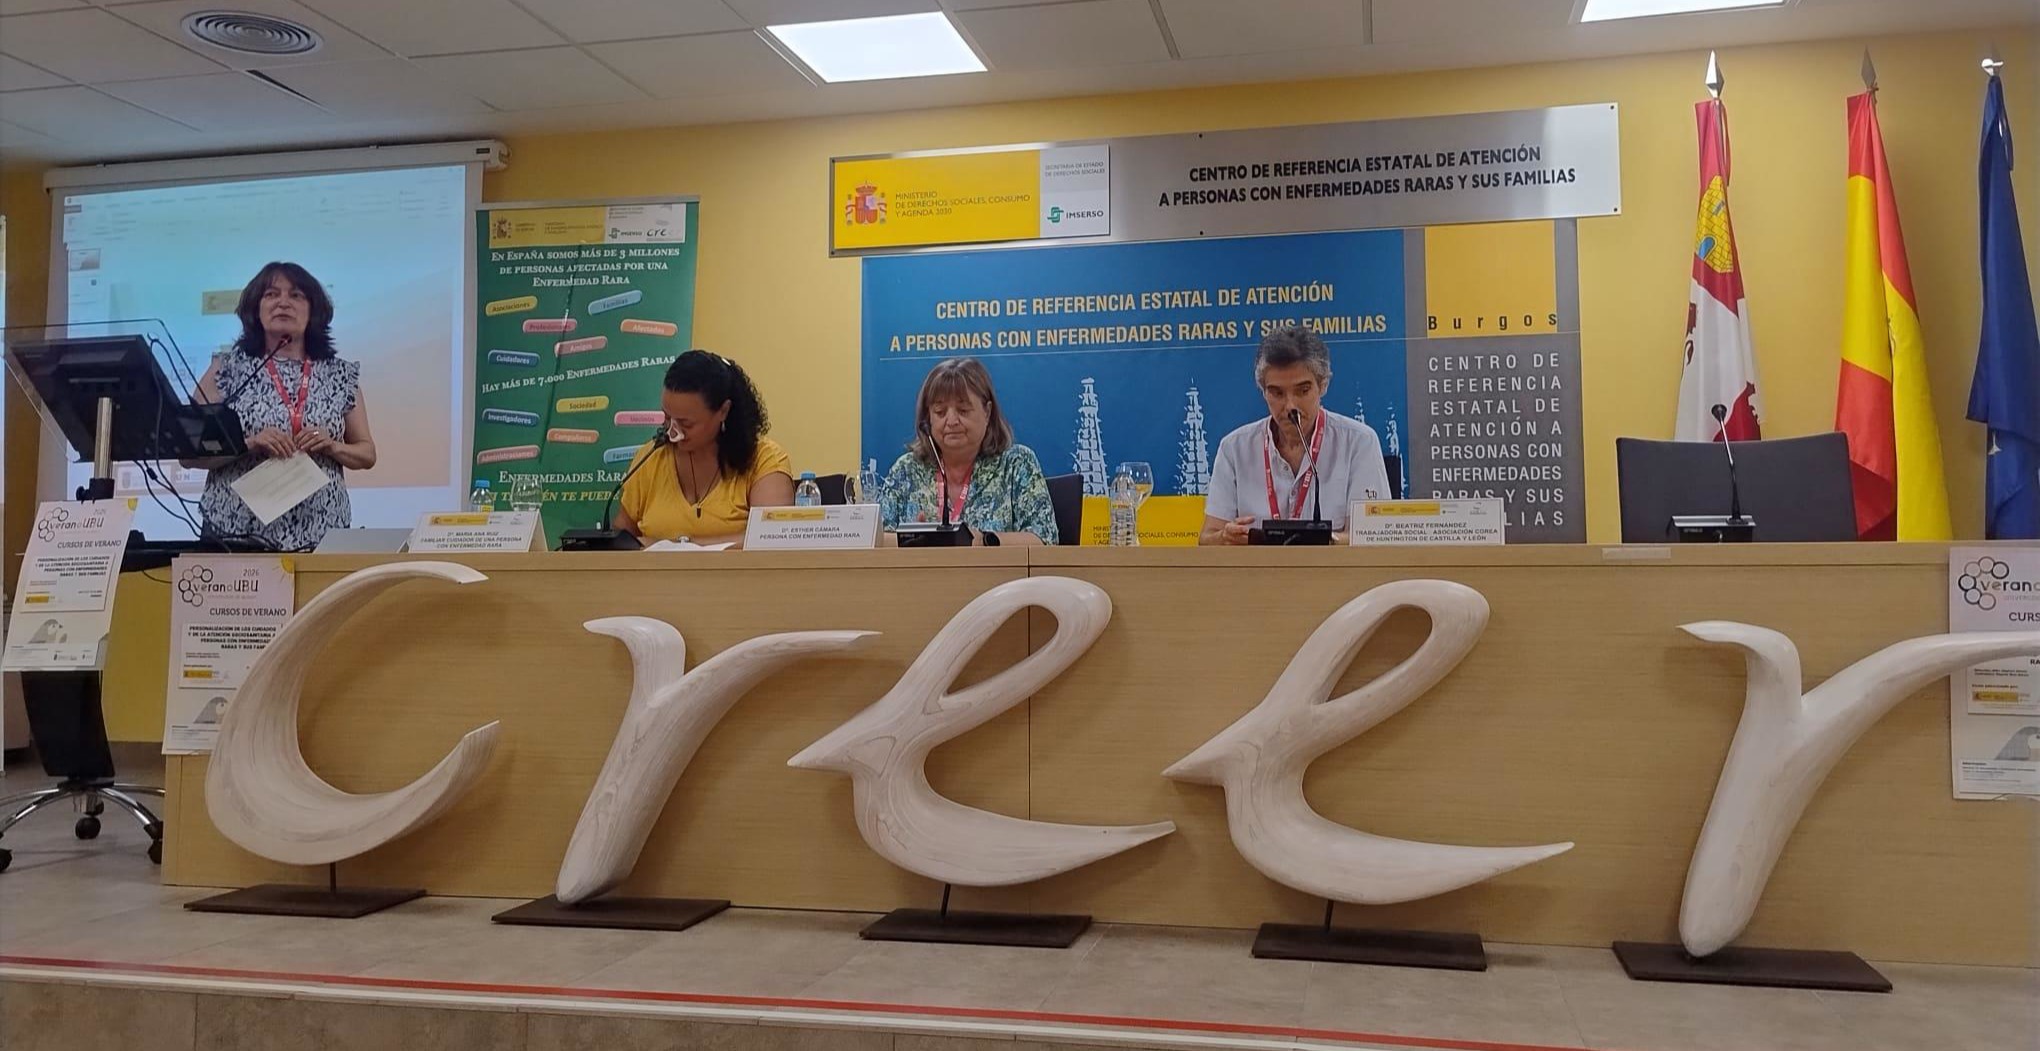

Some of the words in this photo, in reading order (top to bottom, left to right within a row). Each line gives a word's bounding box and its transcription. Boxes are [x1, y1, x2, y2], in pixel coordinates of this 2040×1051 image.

[1189, 165, 1247, 182] CENTRO
[1251, 163, 1269, 179] DE
[1273, 158, 1361, 178] REFERENCIA
[1365, 153, 1432, 172] ESTATAL
[1436, 152, 1455, 168] DE
[1459, 144, 1541, 166] ATENCIÓN
[896, 190, 937, 200] MINISTERIO
[1159, 192, 1169, 207] A
[1173, 187, 1246, 206] PERSONAS
[1250, 184, 1281, 201] CON
[1286, 179, 1400, 200] ENFERMEDADES
[1404, 176, 1453, 193] RARAS
[1457, 174, 1467, 189] Y
[1471, 172, 1499, 188] SUS
[1504, 168, 1575, 187] FAMILIAS
[896, 201, 905, 209] DE
[907, 199, 949, 209] DERECHOS
[988, 195, 1030, 206] CONSUMO
[902, 208, 933, 217] AGENDA
[1066, 210, 1104, 219] IMSERSO
[507, 250, 544, 261] ESPAÑA
[547, 251, 579, 260] SOMOS
[581, 249, 601, 259] MÁS
[604, 250, 617, 258] DE
[629, 248, 680, 258] MILLONES
[500, 267, 513, 275] DE
[515, 265, 564, 275] PERSONAS
[566, 264, 622, 274] AFECTADAS
[624, 262, 645, 271] POR
[647, 262, 668, 271] UNA
[936, 299, 1000, 319] CENTRO
[1006, 298, 1027, 316] DE
[1032, 293, 1136, 314] REFERENCIA
[1141, 289, 1212, 310] ESTATAL
[1218, 289, 1240, 306] DE
[1246, 280, 1333, 305] ATENCIÓN
[1428, 314, 1557, 331] Burgos
[890, 335, 901, 352] A
[906, 331, 992, 351] PERSONAS
[997, 330, 1031, 348] CON
[1037, 325, 1173, 346] ENFERMEDADES
[1178, 321, 1237, 341] RARAS
[1243, 321, 1254, 338] Y
[1302, 315, 1386, 335] FAMILIAS
[1429, 354, 1517, 371] CENTRO
[1533, 353, 1559, 368] DE
[523, 378, 536, 387] DE
[566, 360, 640, 379] ENFERMEDADES
[1428, 375, 1561, 394] REFERENCIA
[1431, 399, 1520, 416] ESTATAL
[1535, 398, 1560, 413] DE
[1430, 416, 1537, 437] ATENCIÓN
[1551, 420, 1562, 435] A
[1431, 444, 1520, 460] PERSONAS
[1527, 443, 1562, 458] CON
[499, 470, 593, 484] ENFERMEDADES
[597, 469, 627, 482] RARA
[1432, 466, 1561, 482] ENFERMEDADES
[1505, 489, 1515, 503] Y
[1526, 488, 1563, 503] SUS
[57, 541, 83, 549] CURSOS
[95, 539, 121, 548] VERANO
[1981, 580, 2040, 592] verano
[210, 608, 240, 616] CURSOS
[242, 608, 252, 616] DE
[254, 608, 286, 617] VERANO
[2008, 612, 2040, 622] CURS
